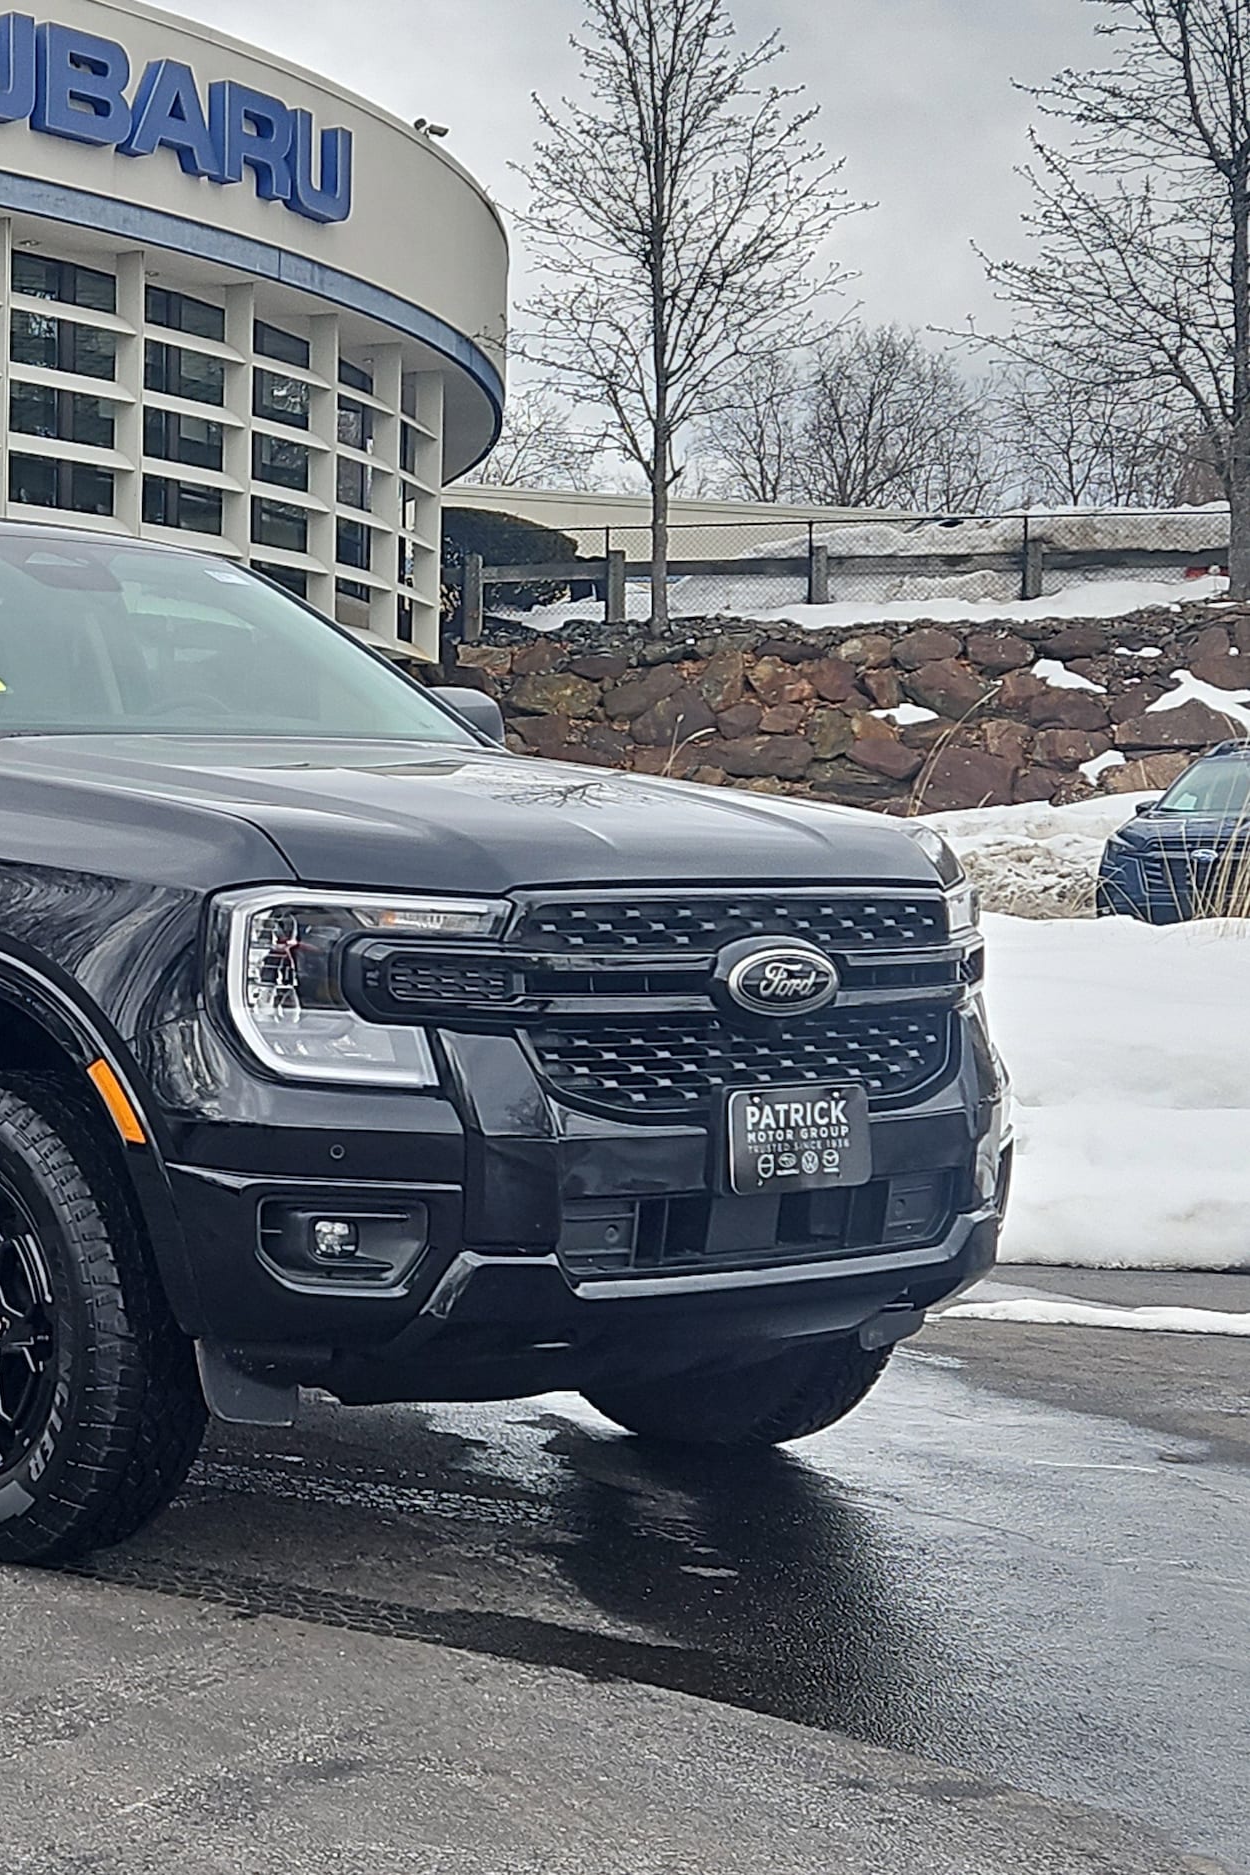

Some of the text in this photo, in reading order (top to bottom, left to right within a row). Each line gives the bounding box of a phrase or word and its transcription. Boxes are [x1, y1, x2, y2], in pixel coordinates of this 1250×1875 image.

[759, 961, 817, 997] Ford
[746, 1100, 848, 1131] PATRICK
[747, 1125, 849, 1143] MOTOR GROUP
[748, 1142, 791, 1154] TRUSTED
[794, 1140, 823, 1151] SINCE
